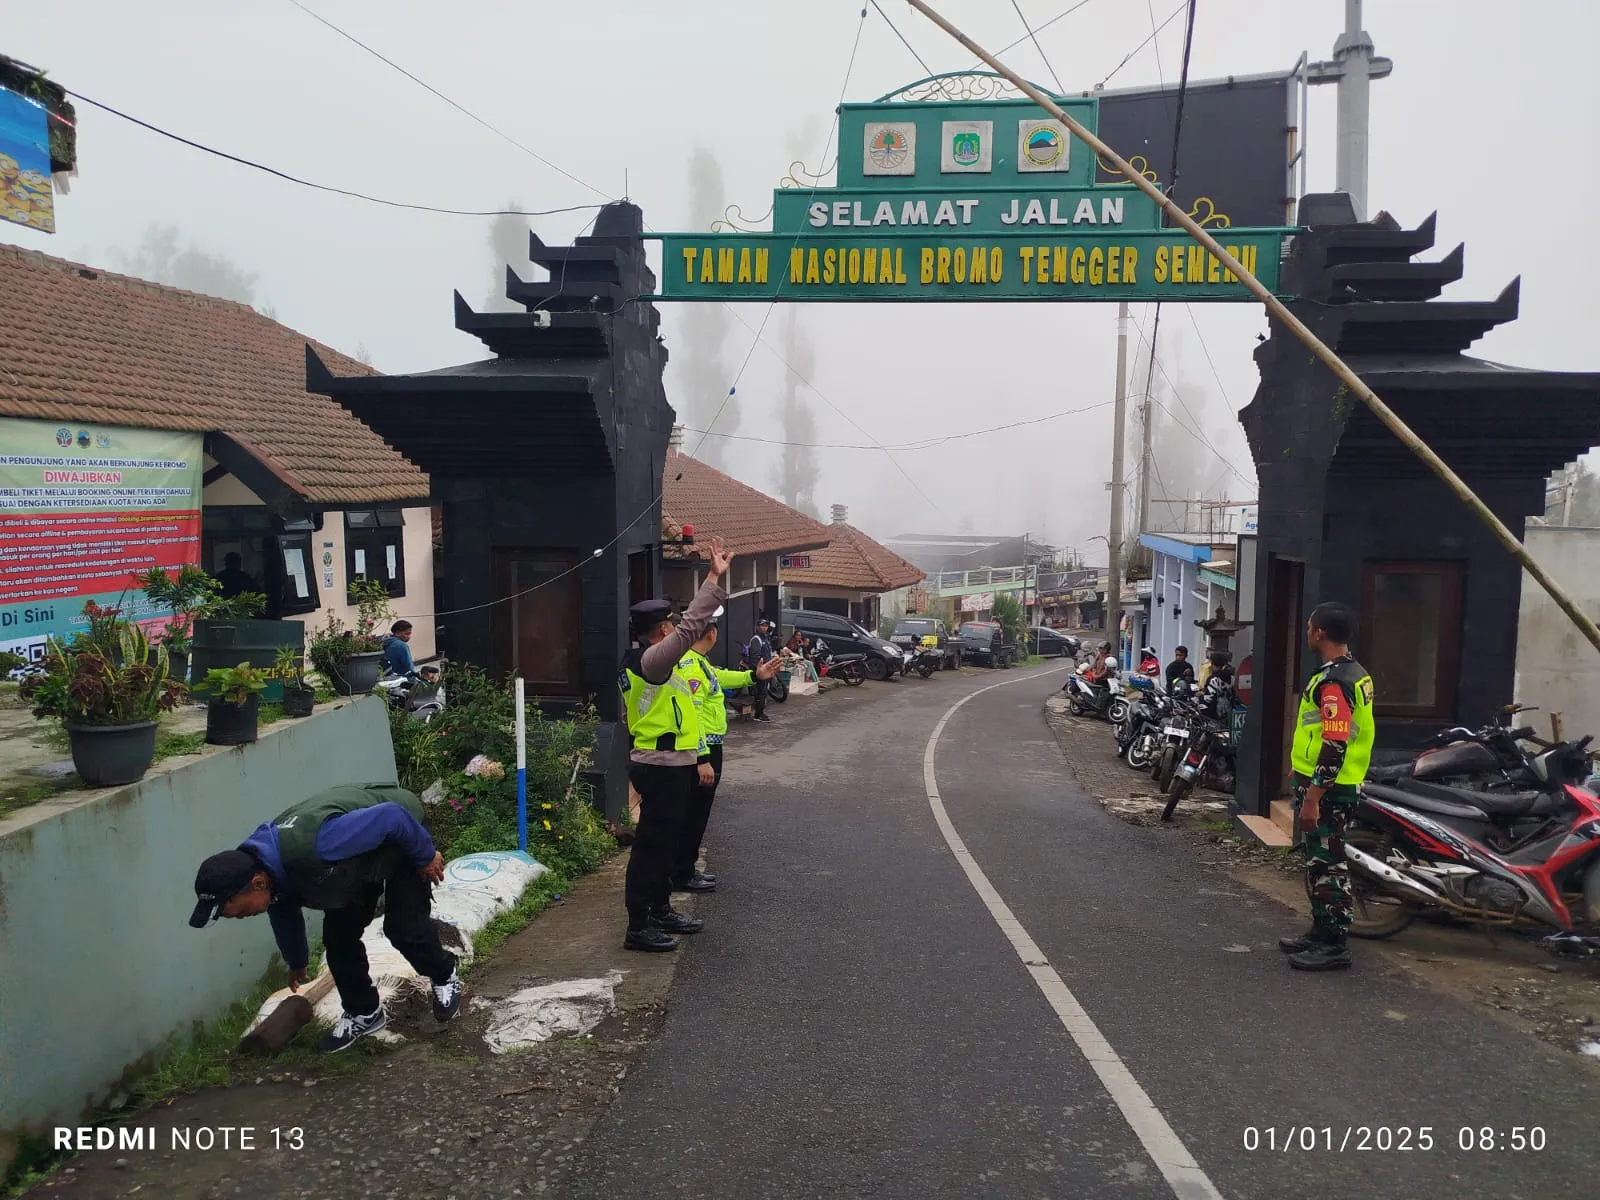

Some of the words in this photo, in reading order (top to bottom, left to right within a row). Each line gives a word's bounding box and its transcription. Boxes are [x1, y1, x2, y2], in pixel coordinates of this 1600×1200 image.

[808, 200, 979, 227] SELAMAT
[1000, 197, 1124, 225] JALAN
[683, 247, 769, 284] TAMAN
[790, 247, 907, 285] NASIONAL
[920, 247, 1003, 285] BROMO
[1019, 246, 1138, 286] TENGGER
[9, 456, 64, 465] PENGUNJUNG
[66, 458, 87, 466] YANG
[89, 459, 109, 467] AKAN
[110, 460, 154, 468] BERKUNJUNG
[45, 471, 121, 483] DIWAJIBKAN
[22, 488, 43, 497] TIKET
[45, 488, 77, 497] MELALUI
[78, 488, 111, 496] BOOKING
[112, 488, 136, 496] ONLINE
[166, 488, 191, 496] DAHULU
[18, 500, 52, 508] DENGAN
[53, 499, 107, 507] KETERSEDIAAN
[2, 610, 18, 627] Di
[24, 604, 55, 624] Sini
